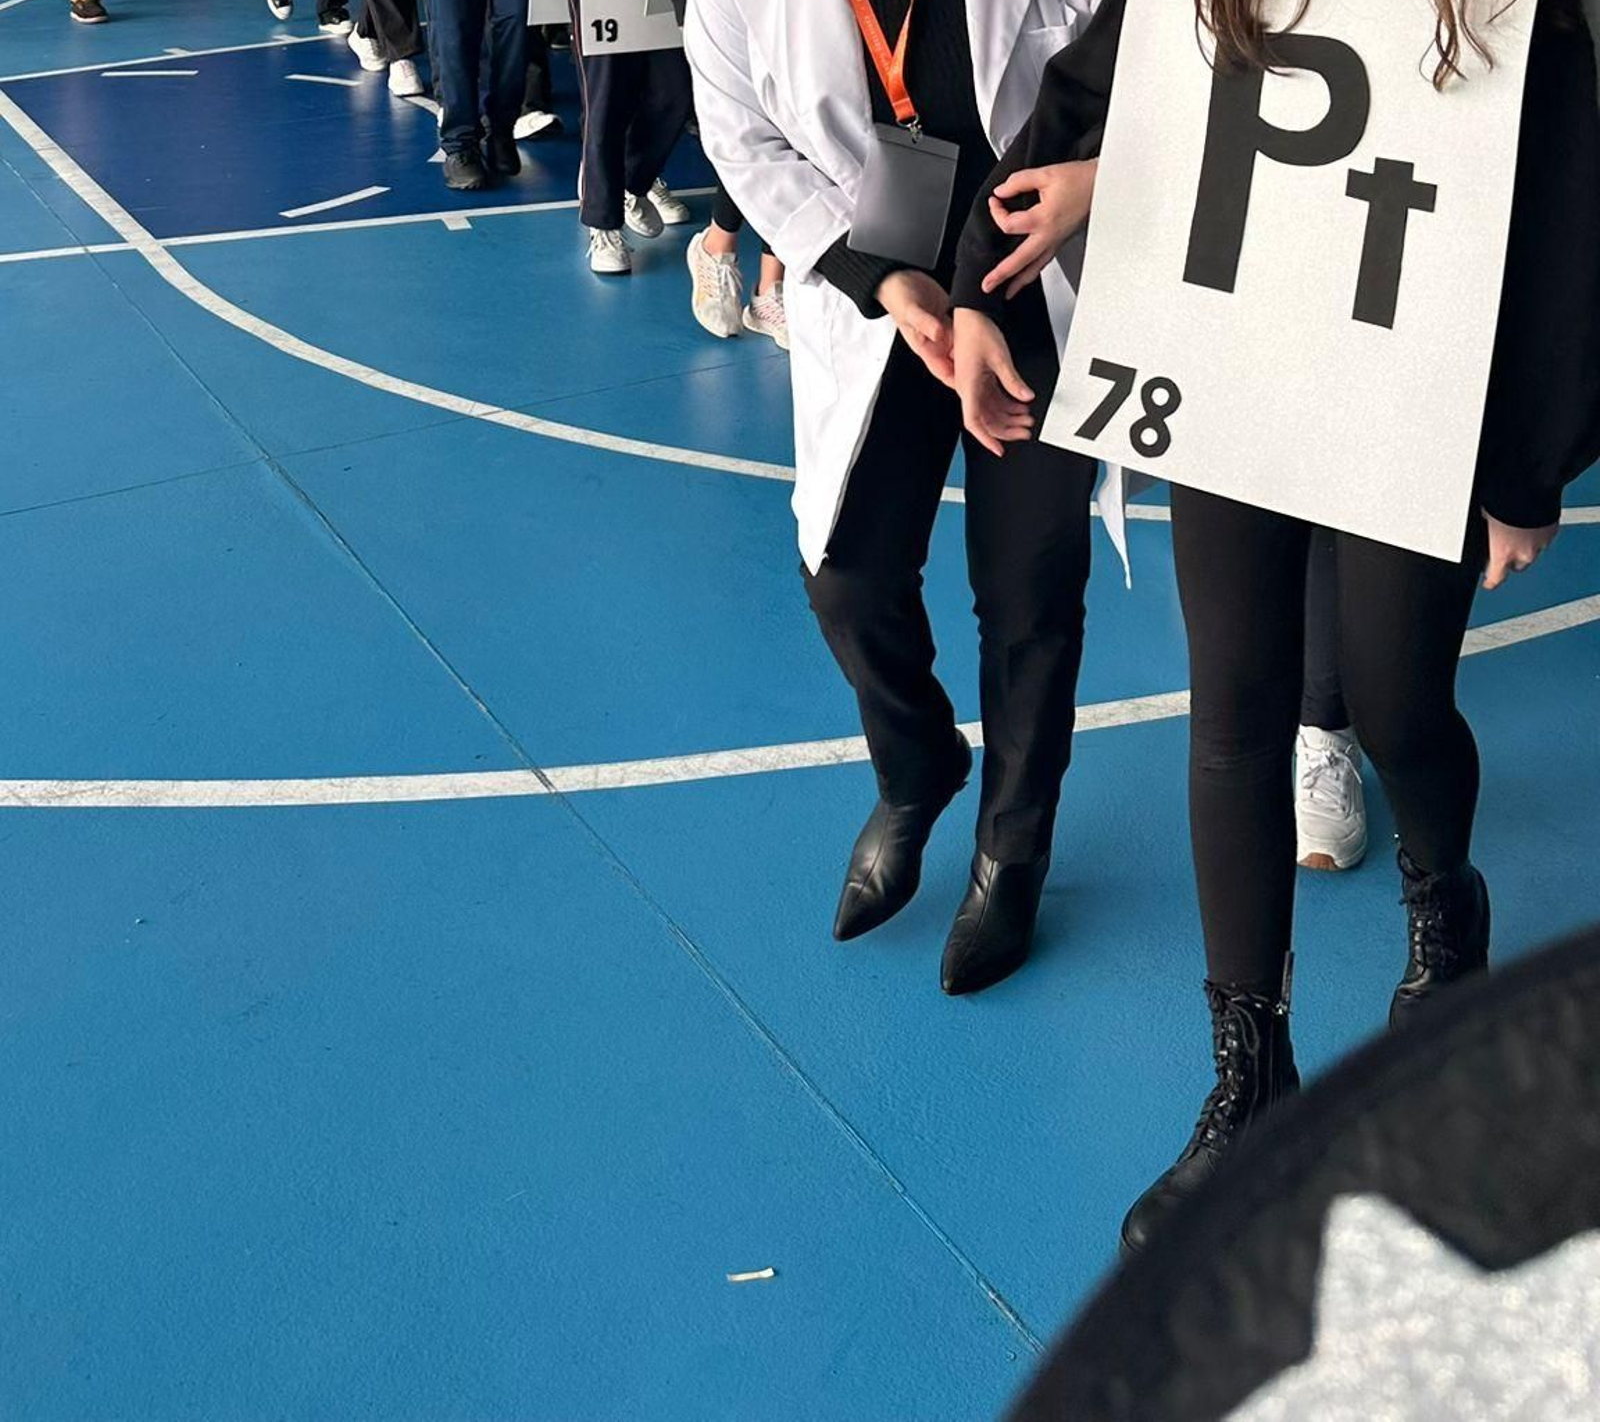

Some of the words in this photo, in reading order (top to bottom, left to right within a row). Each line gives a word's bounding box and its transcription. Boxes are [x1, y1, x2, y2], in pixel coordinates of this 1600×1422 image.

[590, 18, 619, 43] 19
[1182, 32, 1437, 329] Pt
[1074, 357, 1182, 458] 78
